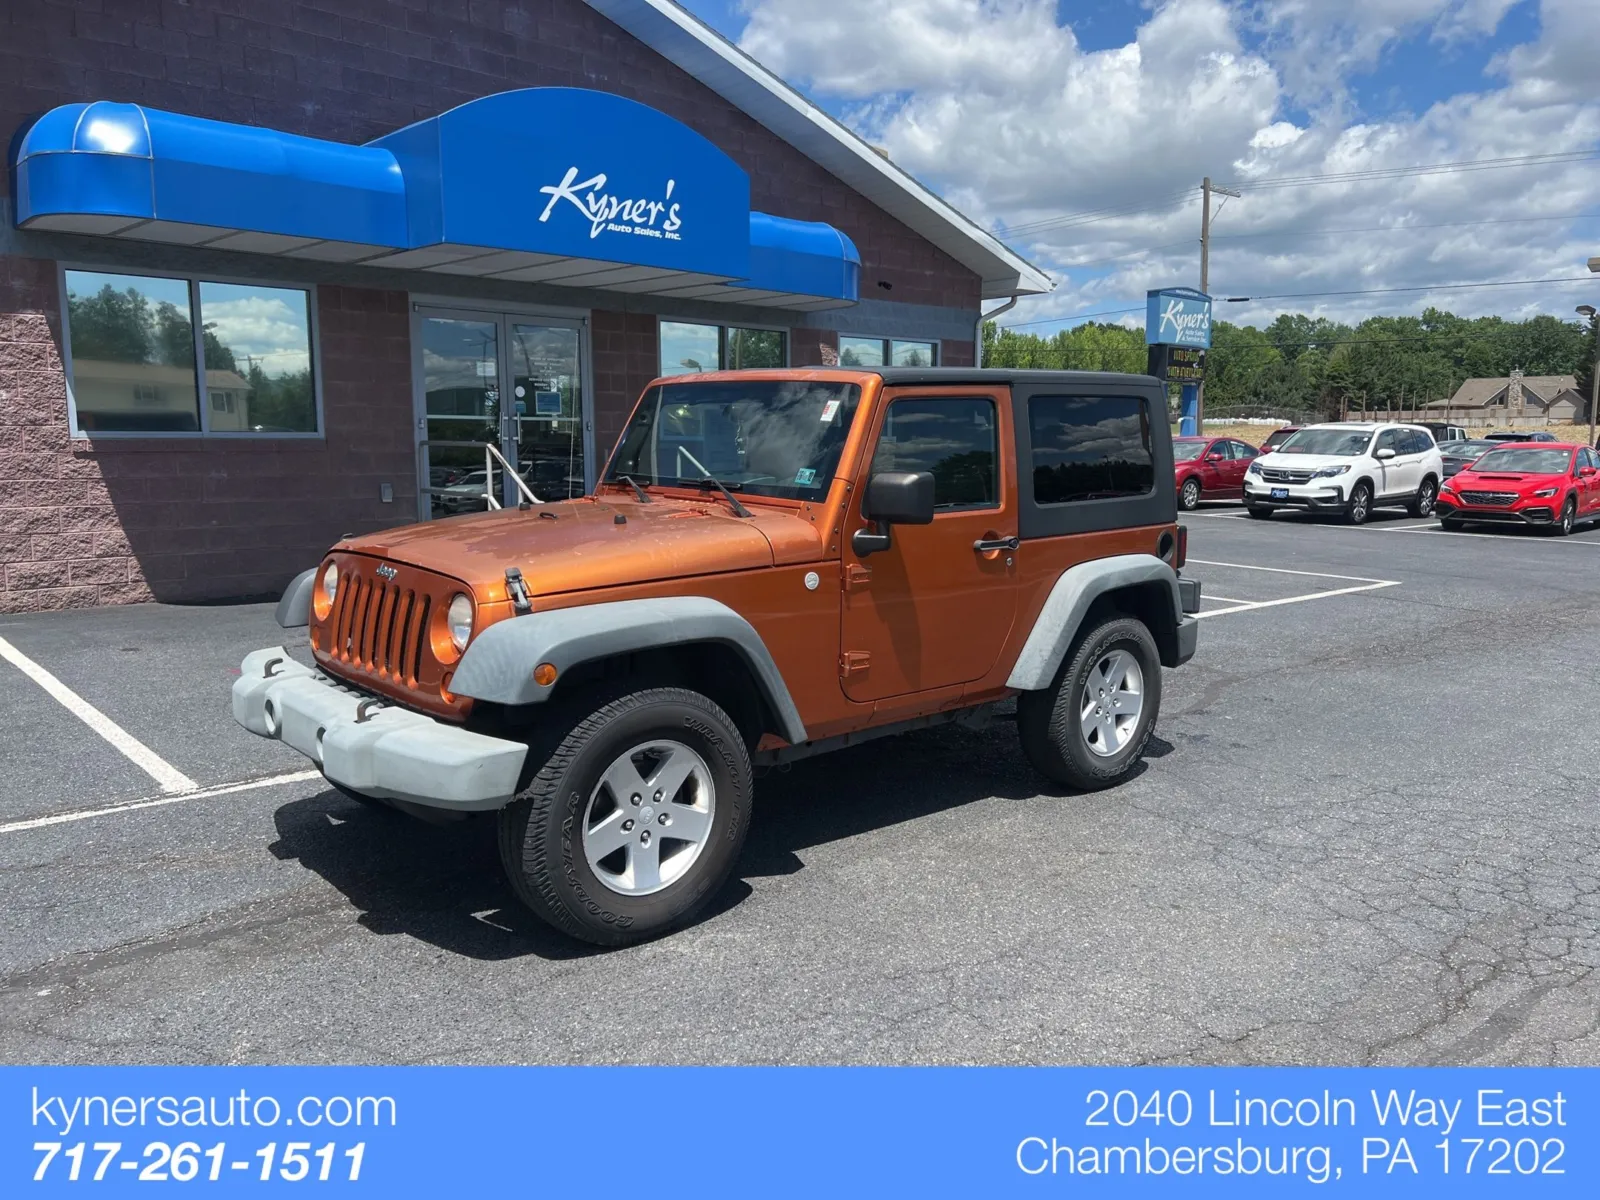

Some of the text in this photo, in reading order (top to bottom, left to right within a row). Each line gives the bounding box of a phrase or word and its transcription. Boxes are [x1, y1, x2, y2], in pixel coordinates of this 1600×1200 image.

[539, 166, 682, 239] Kyner's
[607, 223, 682, 241] Auto Sales, Inc.
[1160, 299, 1209, 343] Kyner's
[376, 562, 398, 581] Jeep
[560, 790, 635, 930] GOODYEAR
